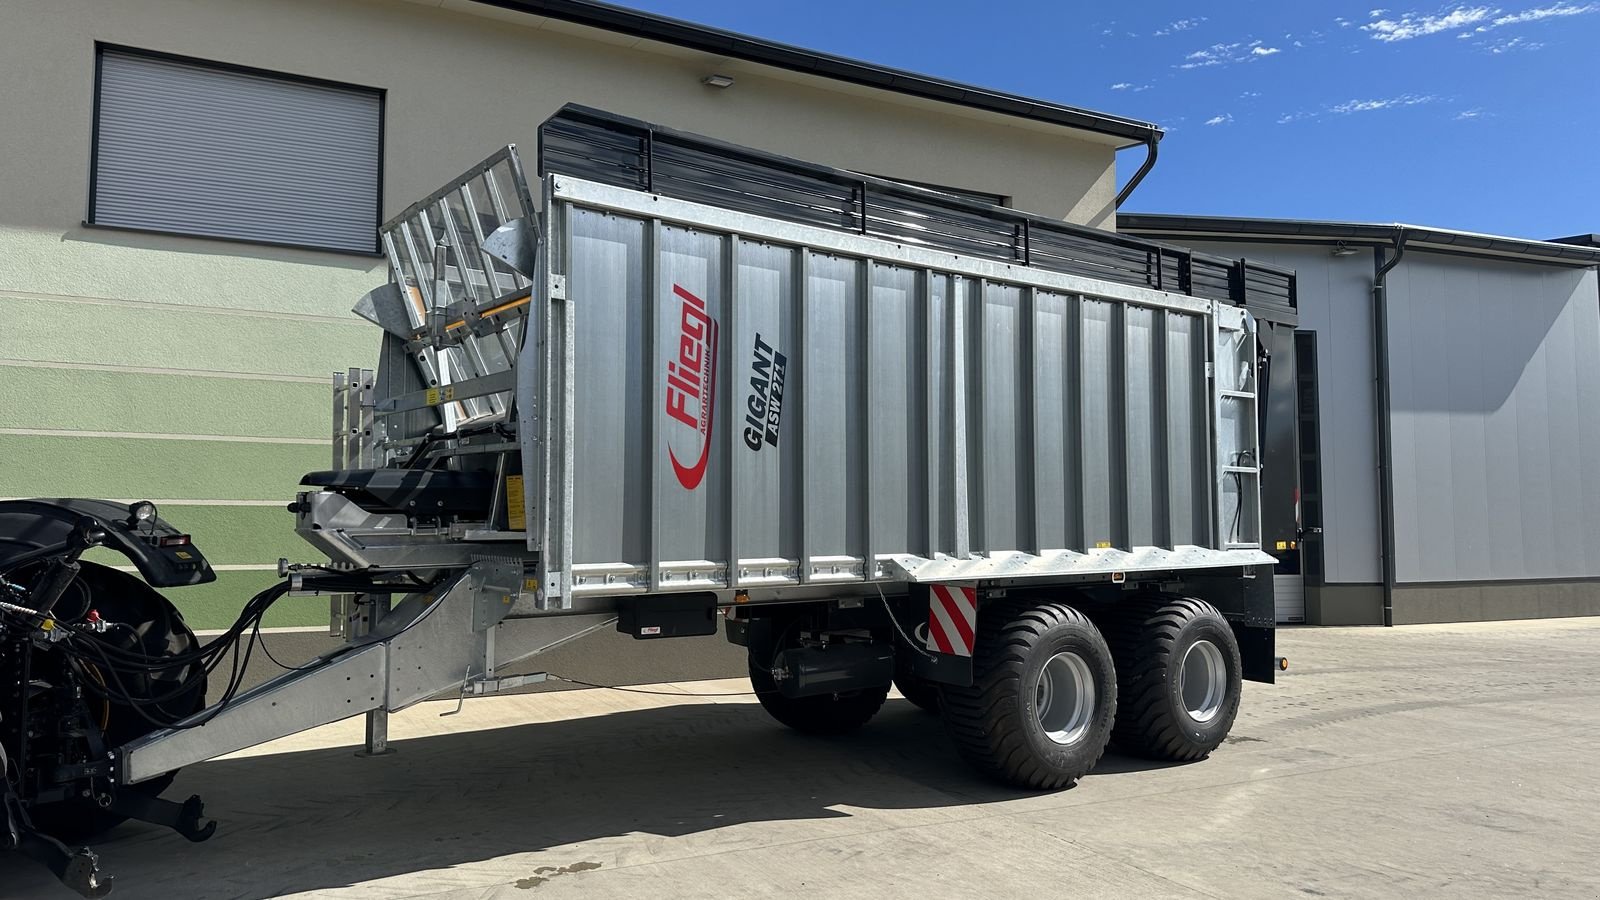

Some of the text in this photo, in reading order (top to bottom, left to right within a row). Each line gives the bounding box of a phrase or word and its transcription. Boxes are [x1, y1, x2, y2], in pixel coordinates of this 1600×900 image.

[666, 283, 711, 430] Fliegl
[700, 347, 711, 435] AGRARTECHNIK
[743, 332, 773, 451] GIGANT
[767, 363, 785, 436] ASW 271
